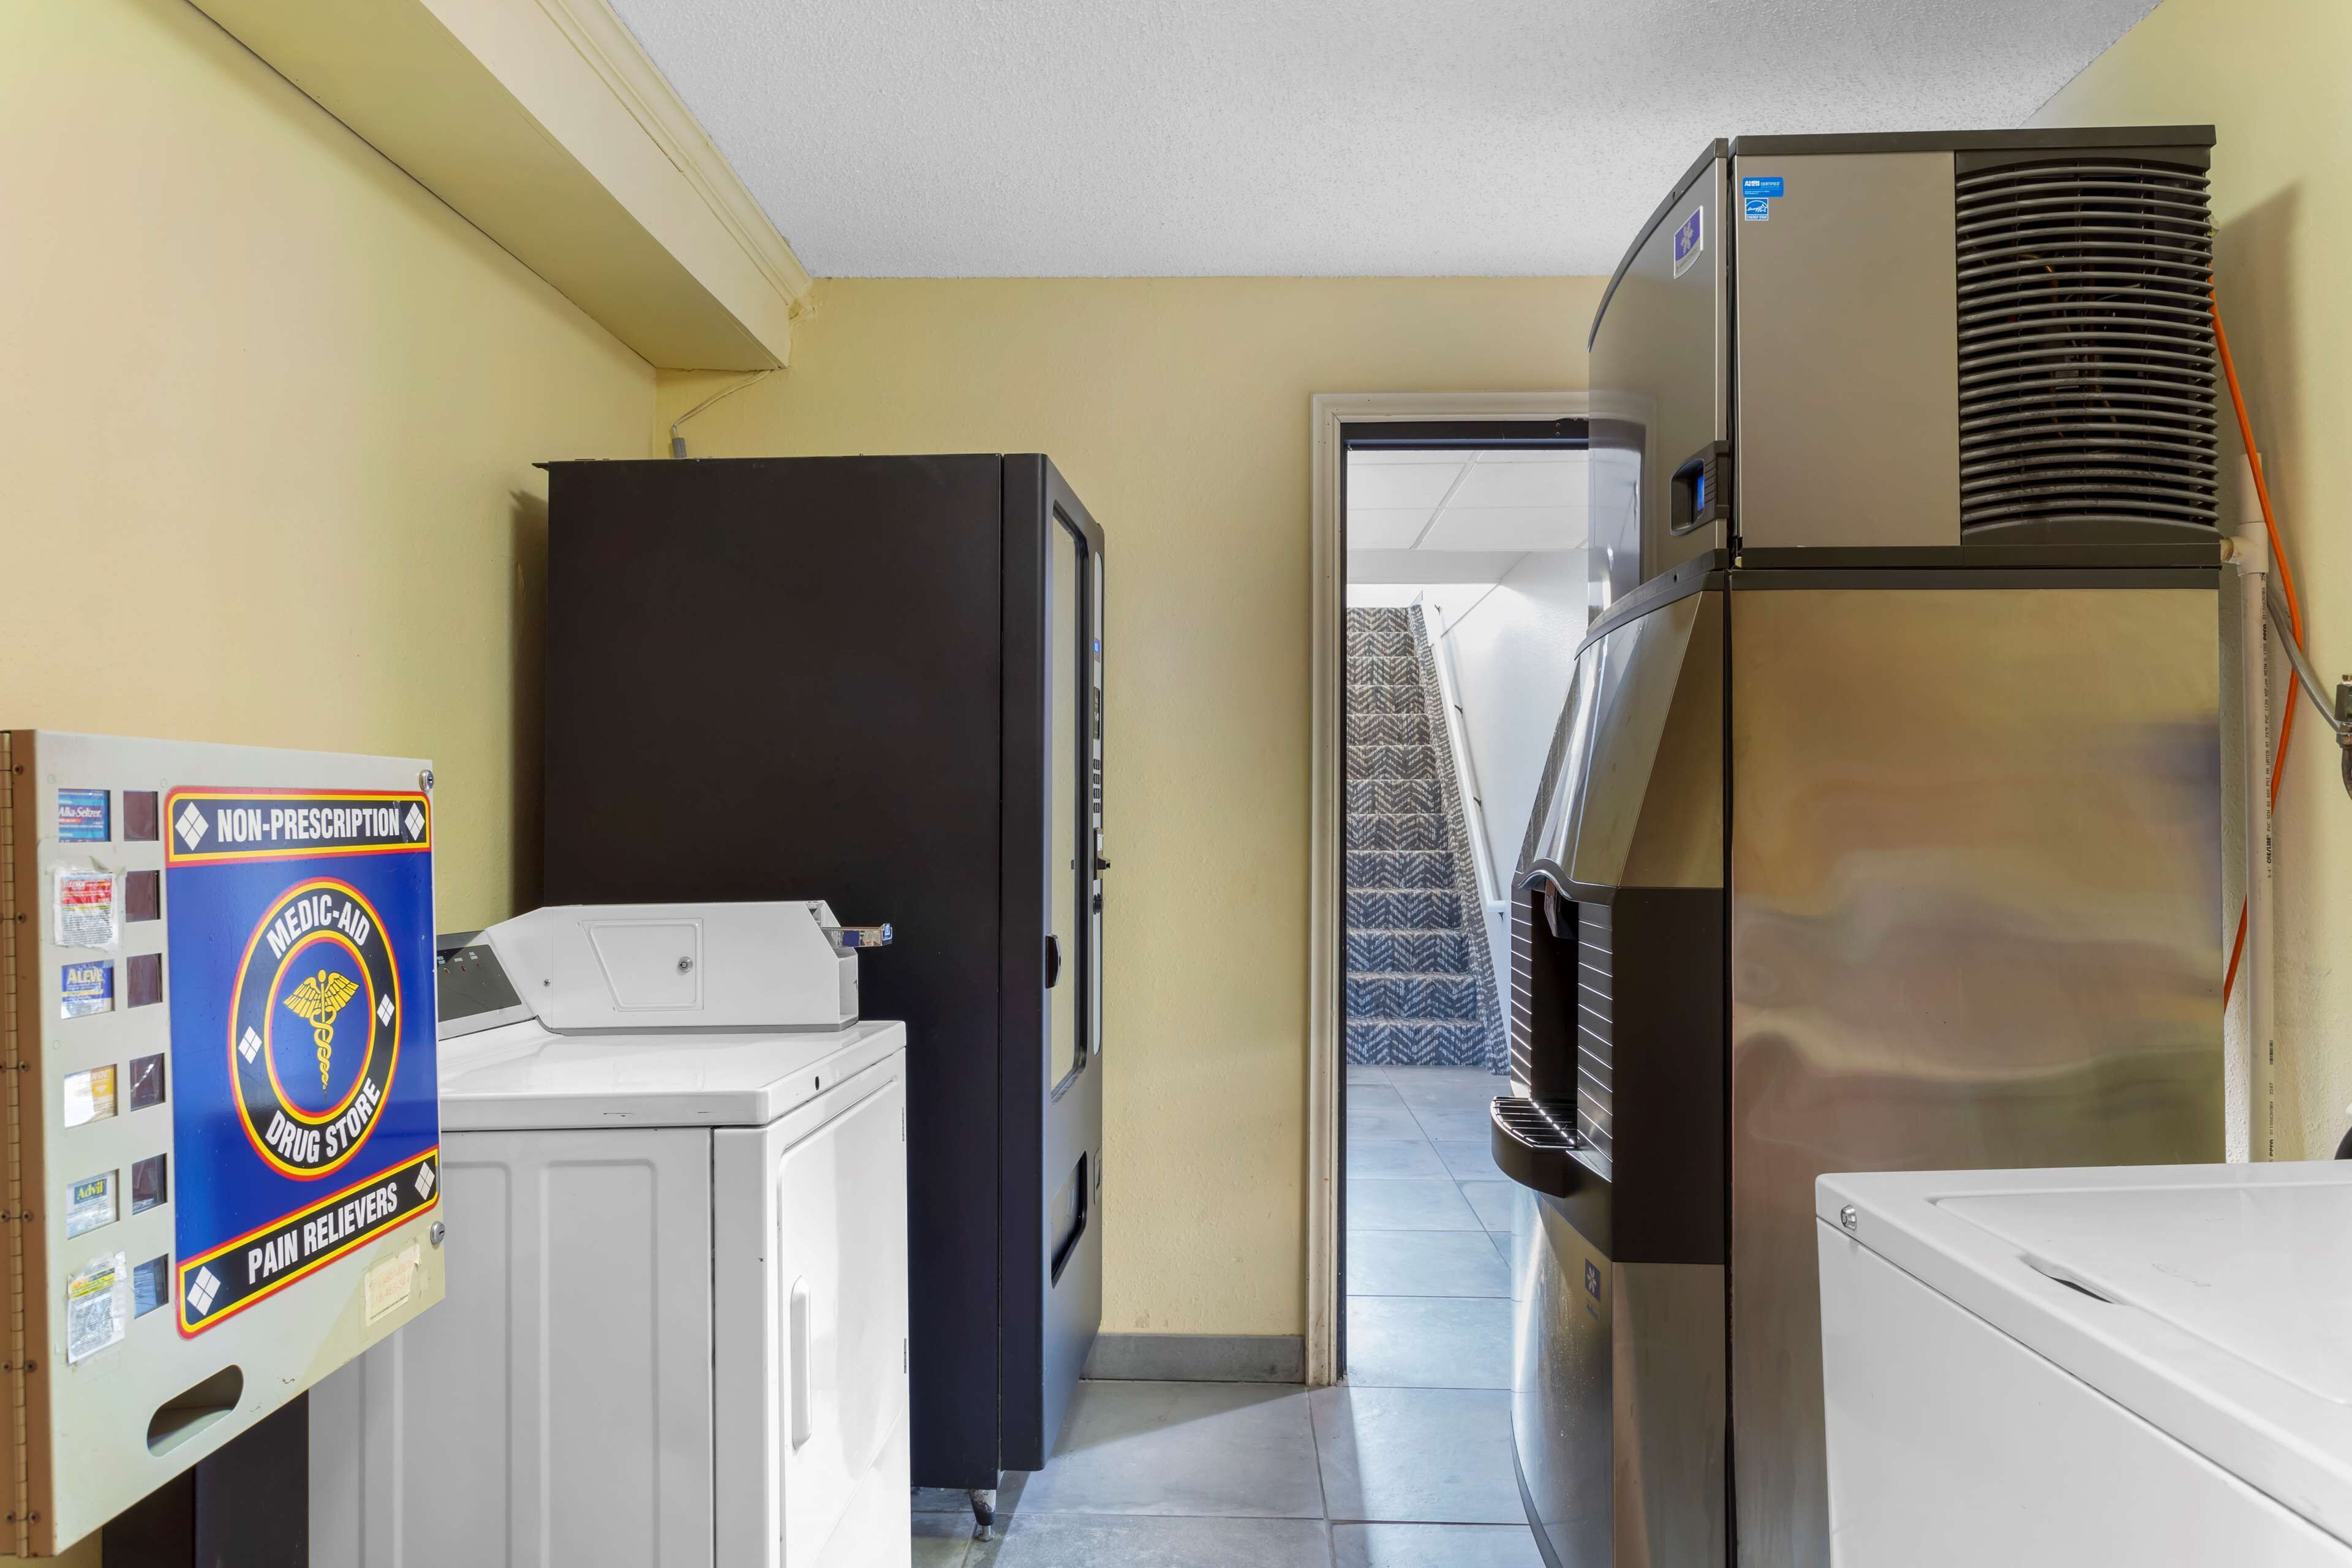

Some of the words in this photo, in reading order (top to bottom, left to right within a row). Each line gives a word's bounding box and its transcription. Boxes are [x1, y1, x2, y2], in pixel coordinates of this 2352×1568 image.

[217, 808, 399, 842] NON-PRESCRIPTION
[266, 894, 370, 960] MEDIC-AID
[265, 1109, 320, 1163] DRUG
[325, 1077, 380, 1158] STORE
[77, 1180, 104, 1200] Advil
[248, 1230, 298, 1284] PAIN
[304, 1182, 398, 1256] RELIEVERS
